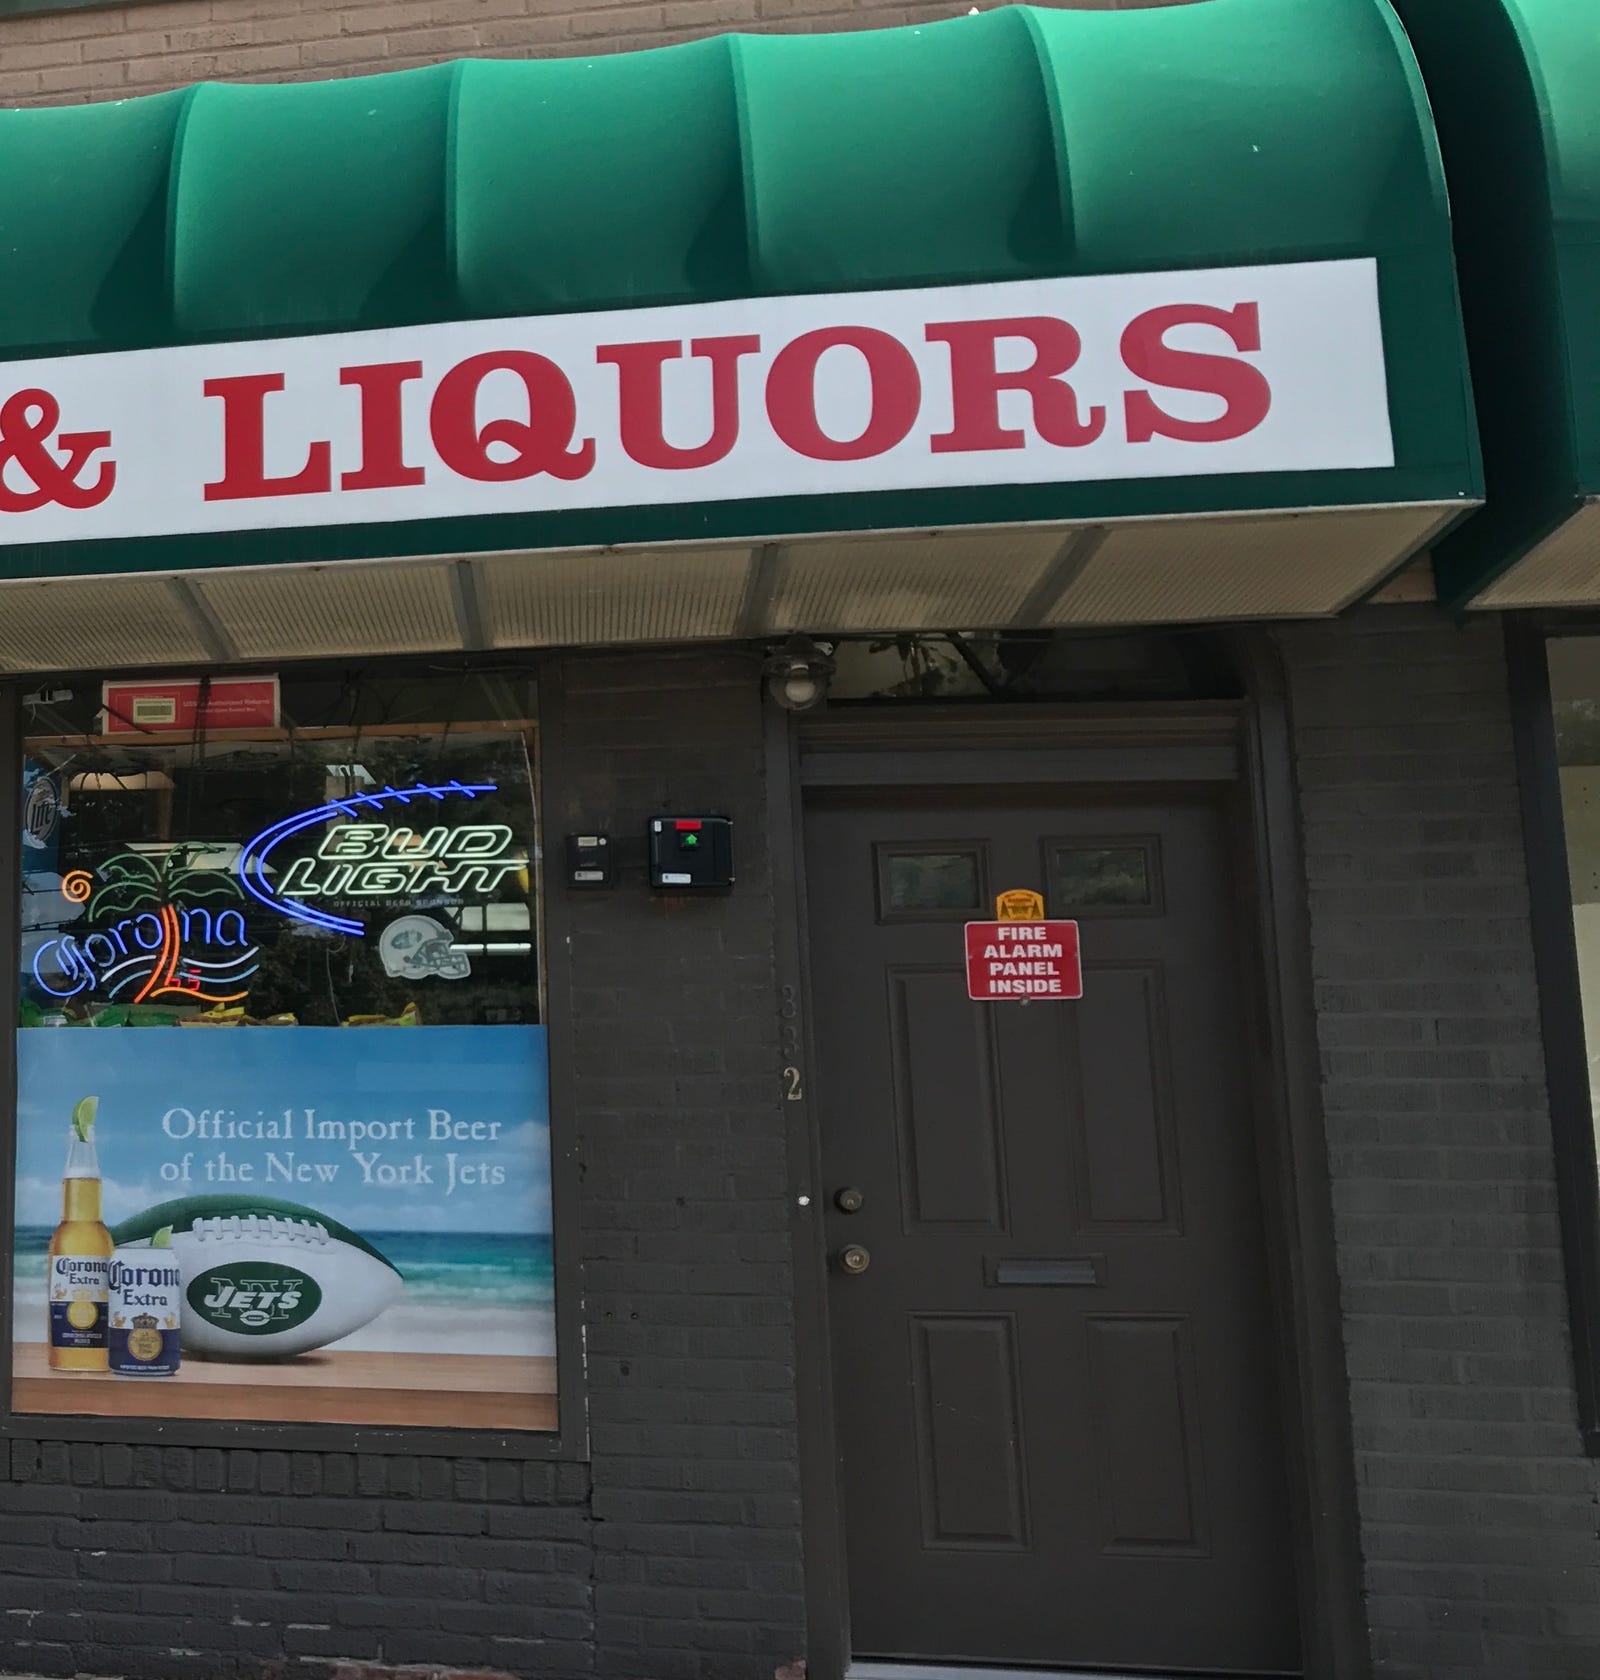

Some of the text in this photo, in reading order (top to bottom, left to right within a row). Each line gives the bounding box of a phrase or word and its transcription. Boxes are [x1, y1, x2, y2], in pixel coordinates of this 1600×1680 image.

[203, 301, 1272, 502] LIQUORS
[317, 824, 513, 861] BUD
[277, 857, 530, 896] LIGHT
[997, 926, 1048, 941] FIRE
[32, 906, 250, 998] Corona
[983, 943, 1063, 959] ALARM
[989, 961, 1060, 976] PANEL
[989, 979, 1062, 994] INSIDE
[161, 1107, 502, 1151] Official Import Beer
[160, 1152, 506, 1197] of the New York Jets
[69, 1273, 100, 1285] Extra
[123, 1289, 168, 1307] Extra
[203, 1286, 303, 1310] JETS
